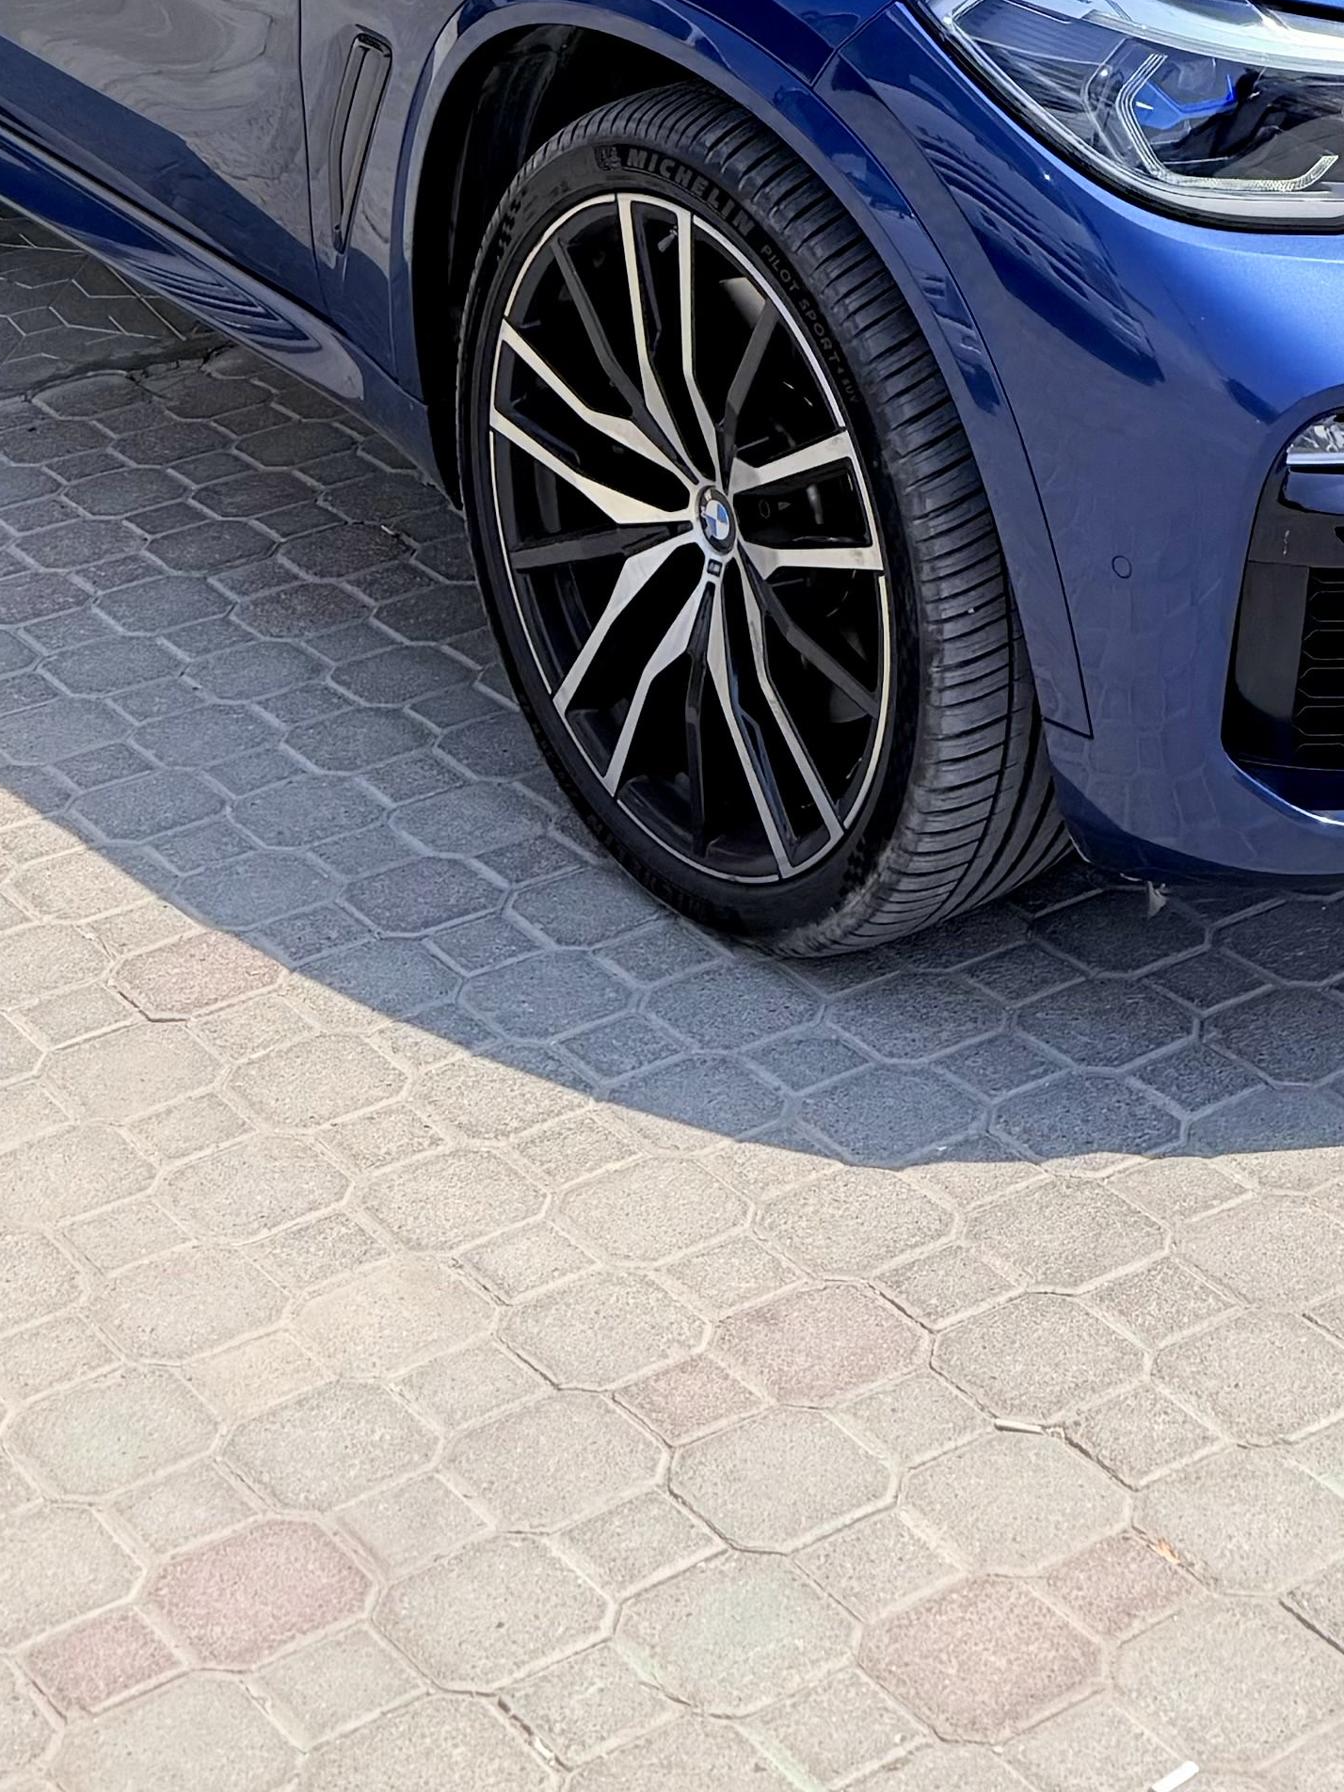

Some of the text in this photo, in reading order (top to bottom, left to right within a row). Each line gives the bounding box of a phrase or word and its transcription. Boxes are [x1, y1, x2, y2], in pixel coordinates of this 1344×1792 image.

[627, 147, 756, 237] MICHELIN
[760, 244, 801, 293] PILOT
[798, 298, 842, 363] SPORT
